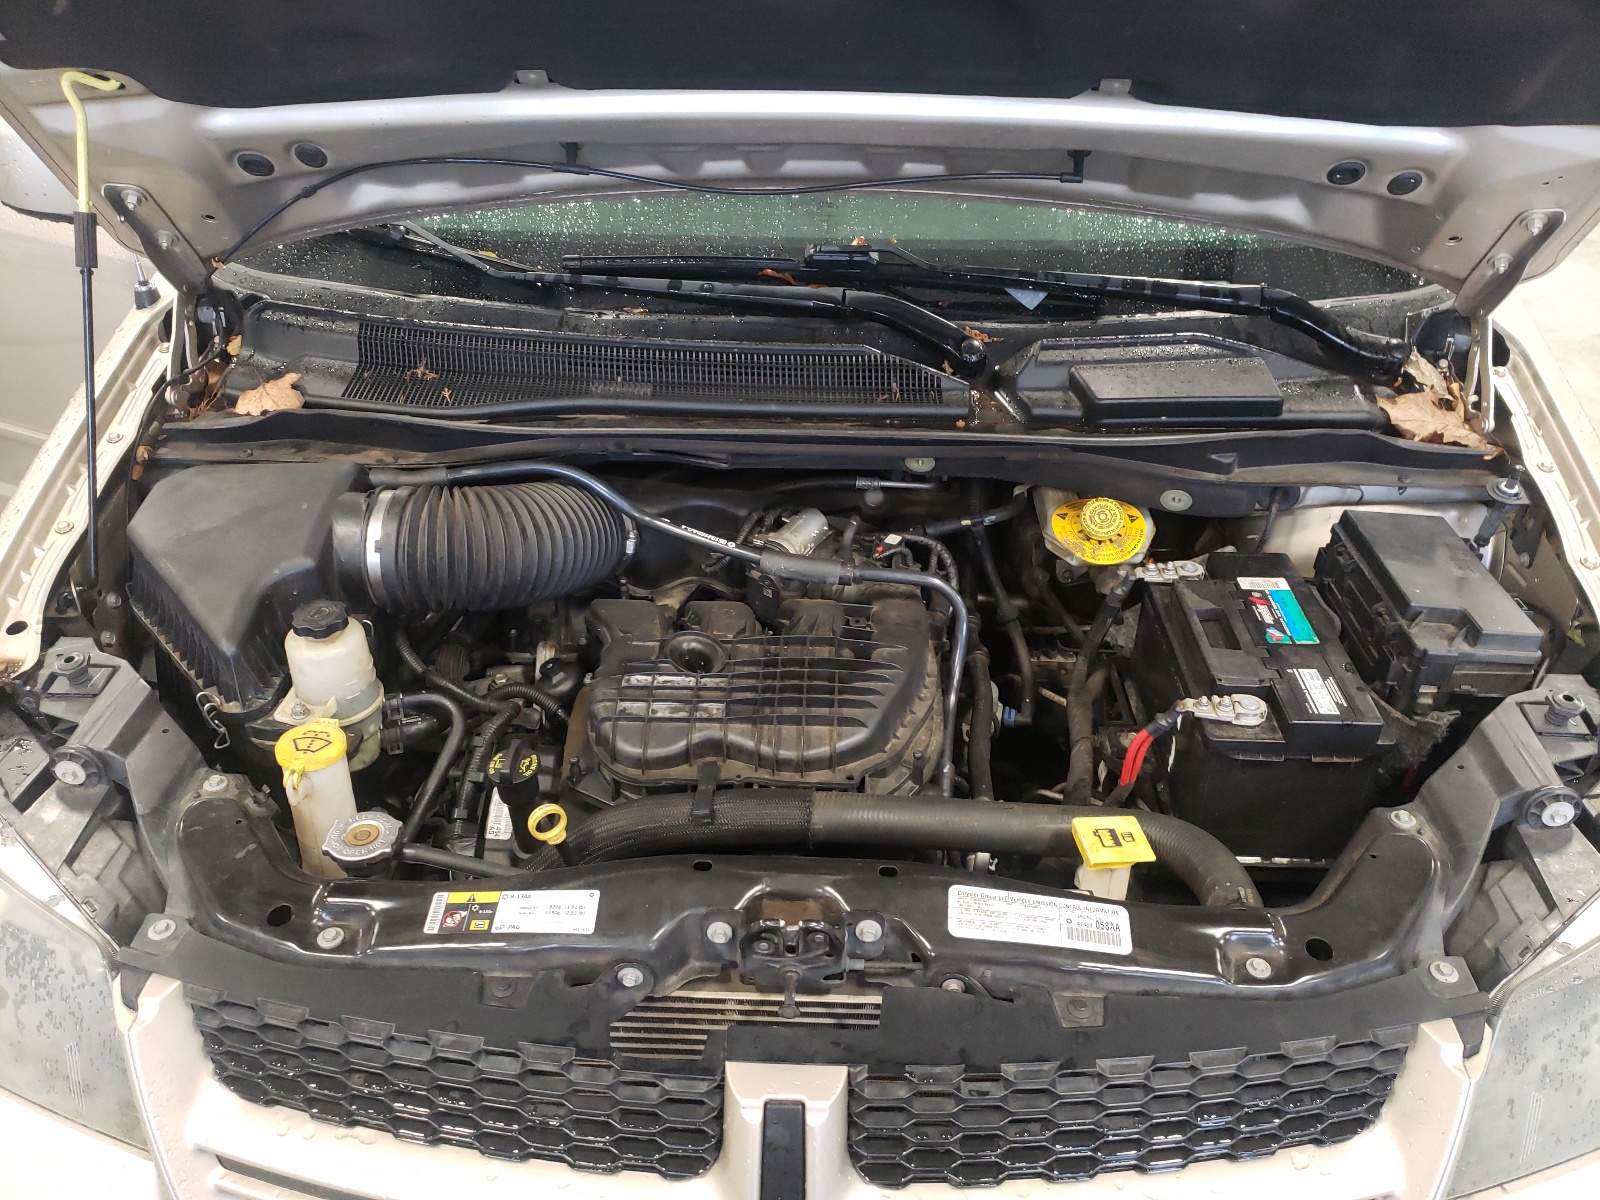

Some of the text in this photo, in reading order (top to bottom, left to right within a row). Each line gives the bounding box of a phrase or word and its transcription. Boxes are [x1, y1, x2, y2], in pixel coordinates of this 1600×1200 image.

[1010, 897, 1031, 905] VEHICLE
[1032, 900, 1058, 908] EMISSION
[1059, 903, 1082, 911] CONTROL
[1083, 906, 1119, 915] INFORMATION
